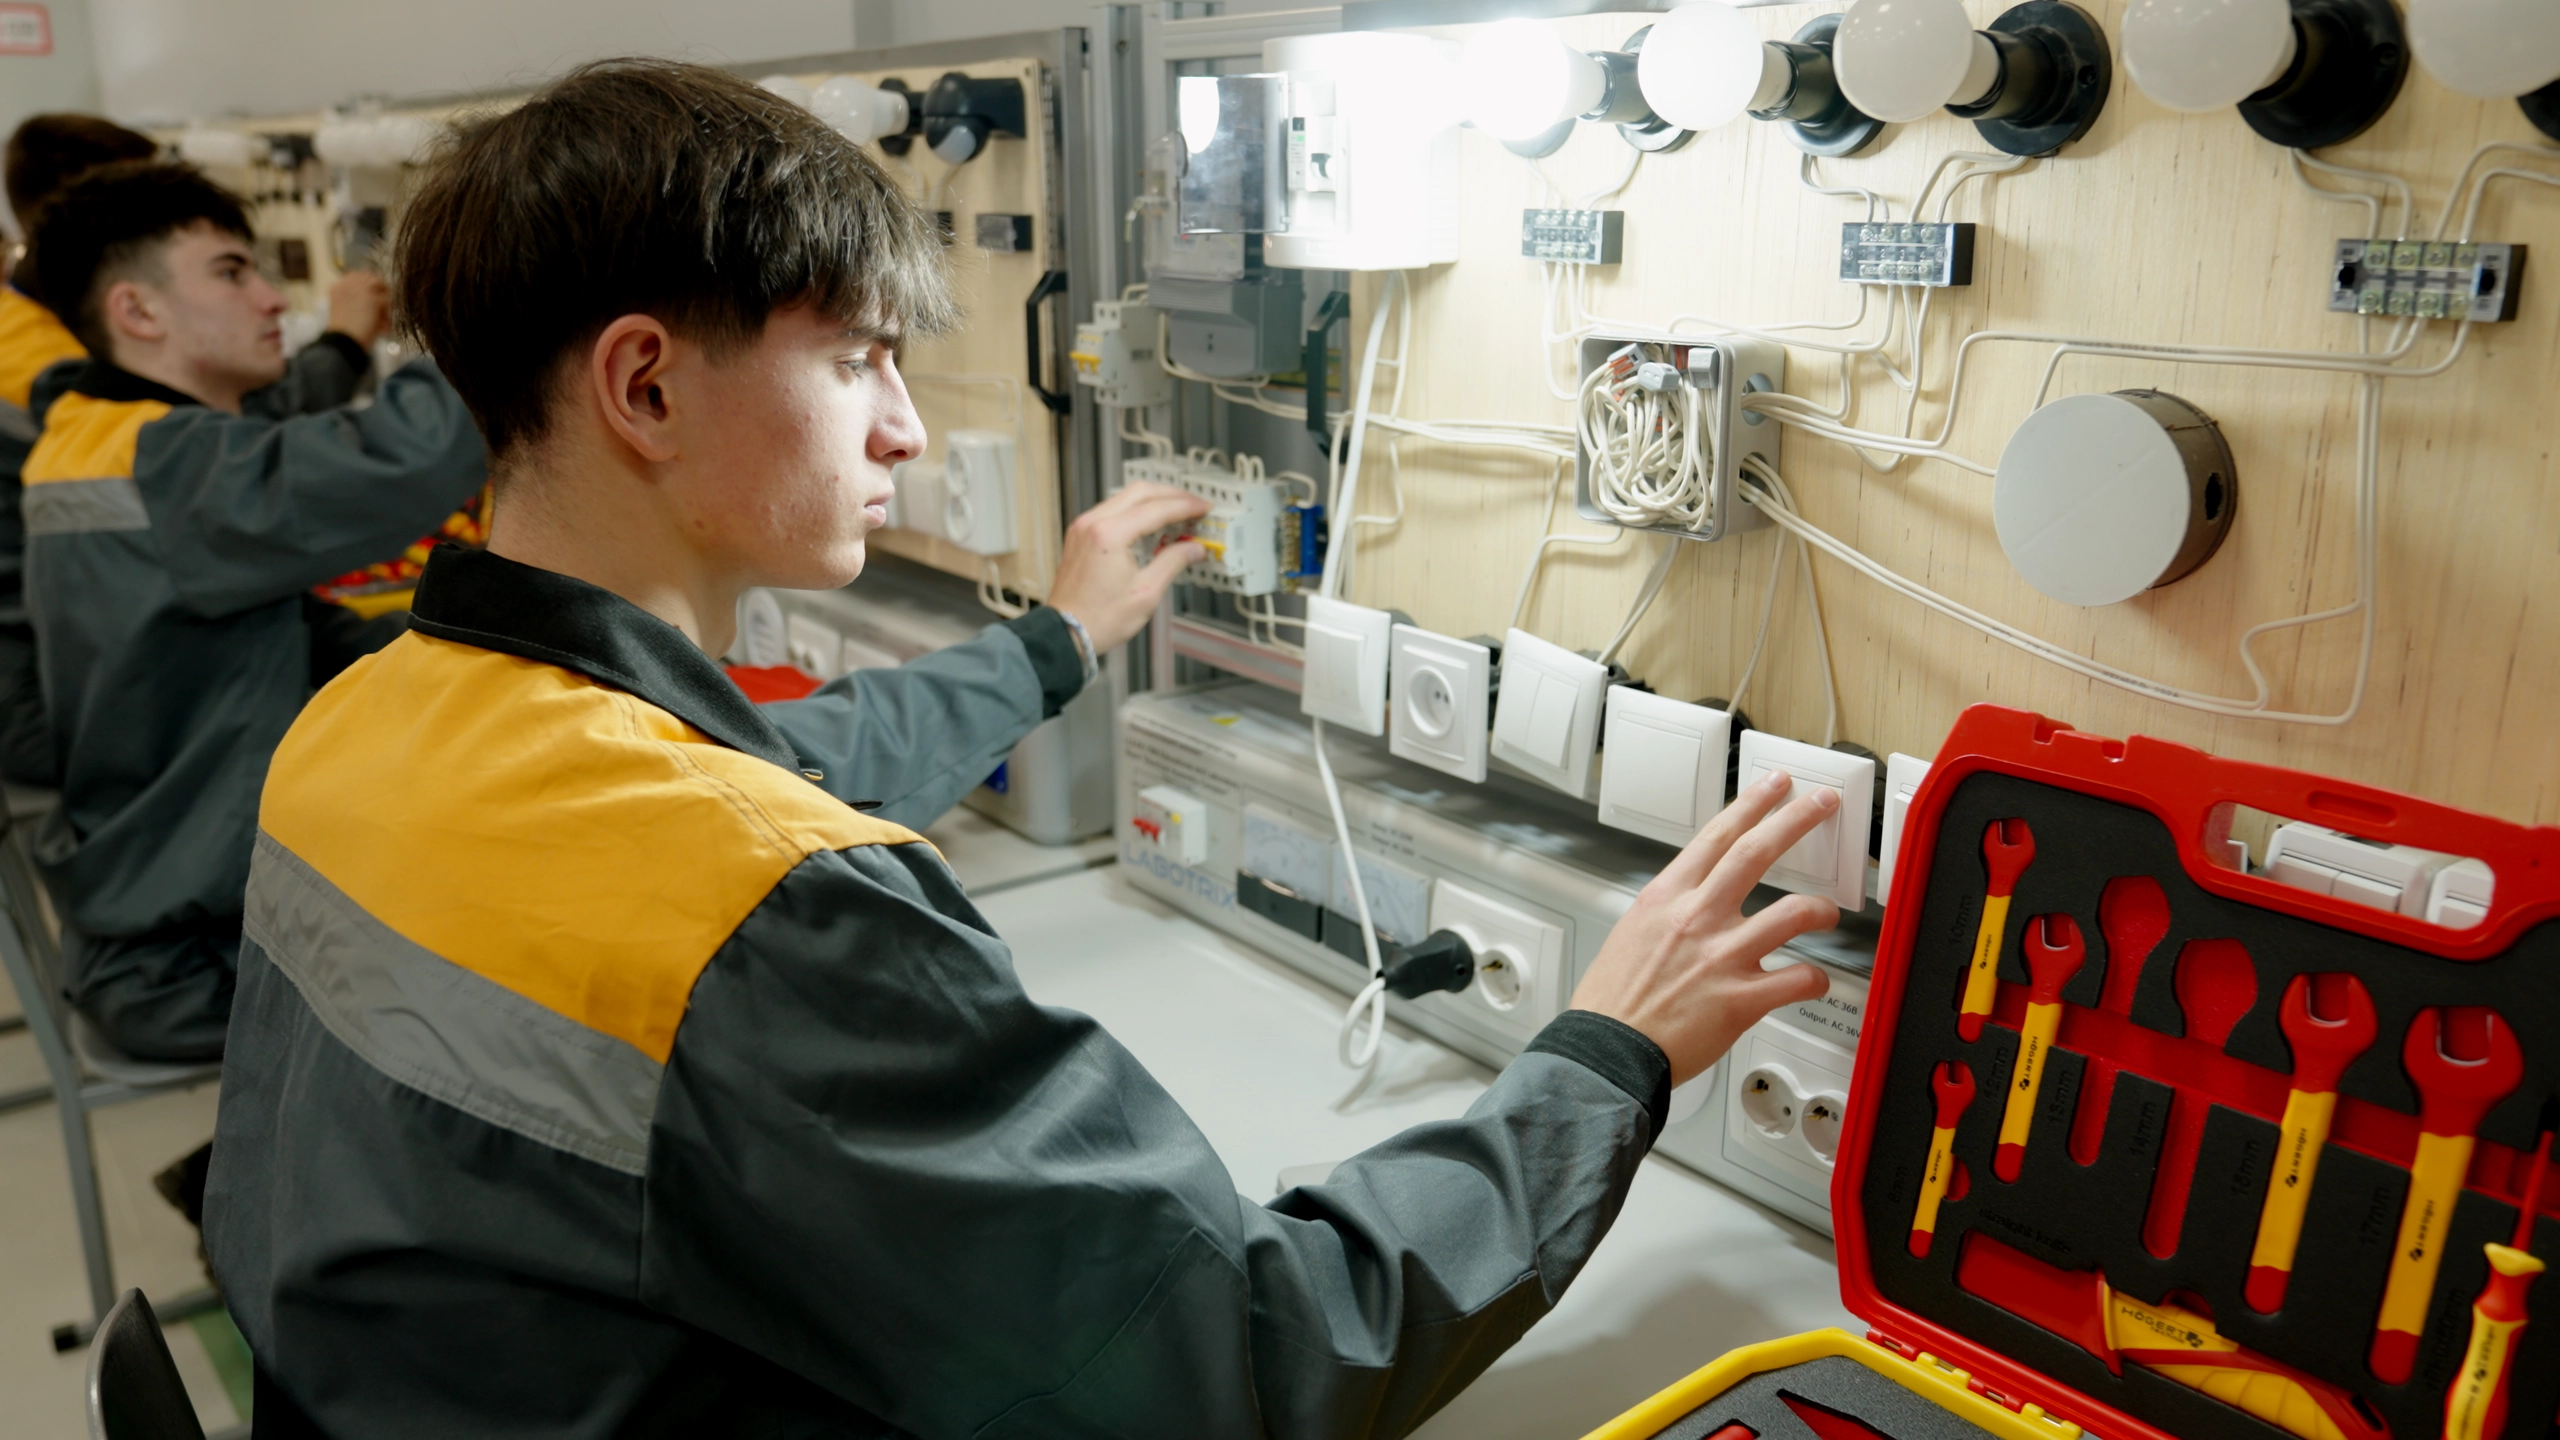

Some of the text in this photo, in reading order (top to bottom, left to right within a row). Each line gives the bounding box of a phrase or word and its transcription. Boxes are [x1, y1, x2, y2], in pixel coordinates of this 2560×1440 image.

[1827, 997, 1840, 1009] AC
[1799, 1006, 1830, 1026] Output:
[1831, 1020, 1844, 1032] AC
